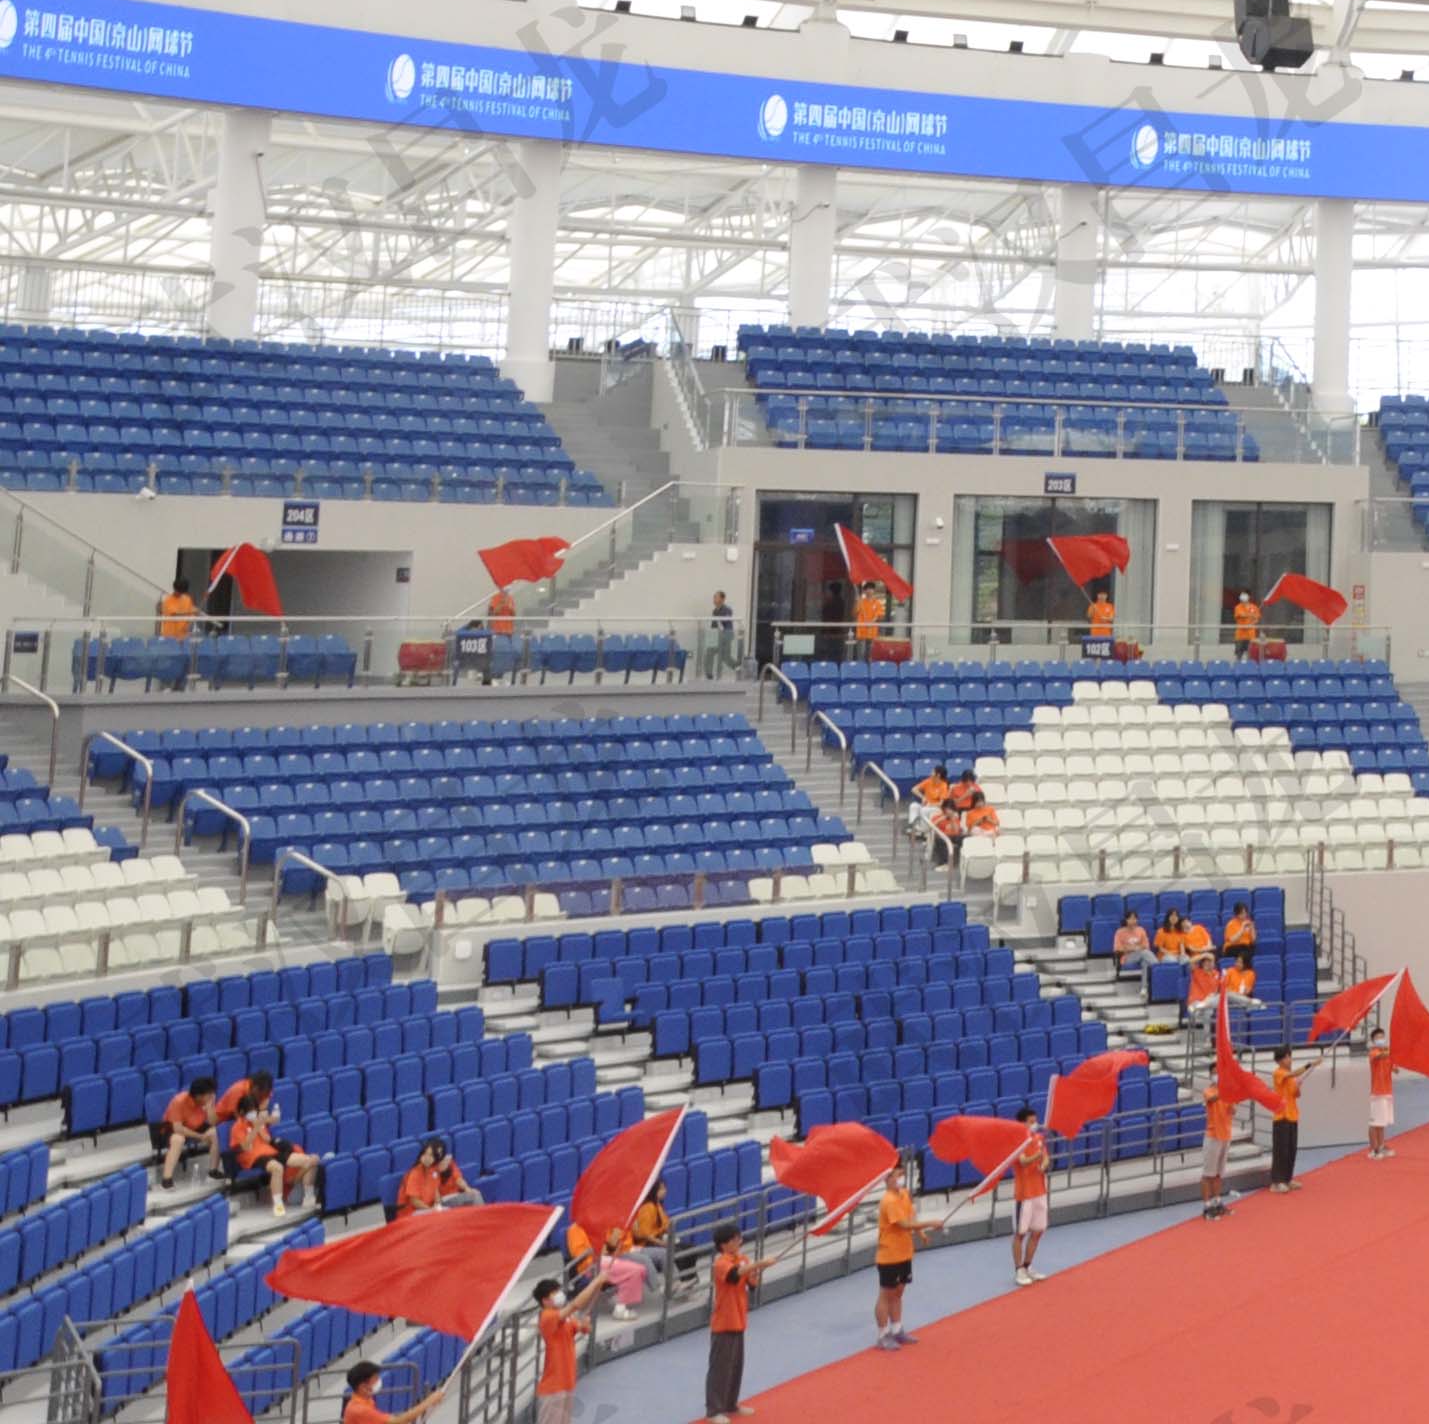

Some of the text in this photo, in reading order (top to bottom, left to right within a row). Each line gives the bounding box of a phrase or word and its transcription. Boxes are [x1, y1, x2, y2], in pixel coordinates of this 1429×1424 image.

[96, 54, 141, 73] FESTIVAL
[160, 62, 190, 78] CHINA
[859, 136, 901, 152] FESTIVAL
[917, 141, 946, 155] CHINA
[460, 638, 487, 653] 103区
